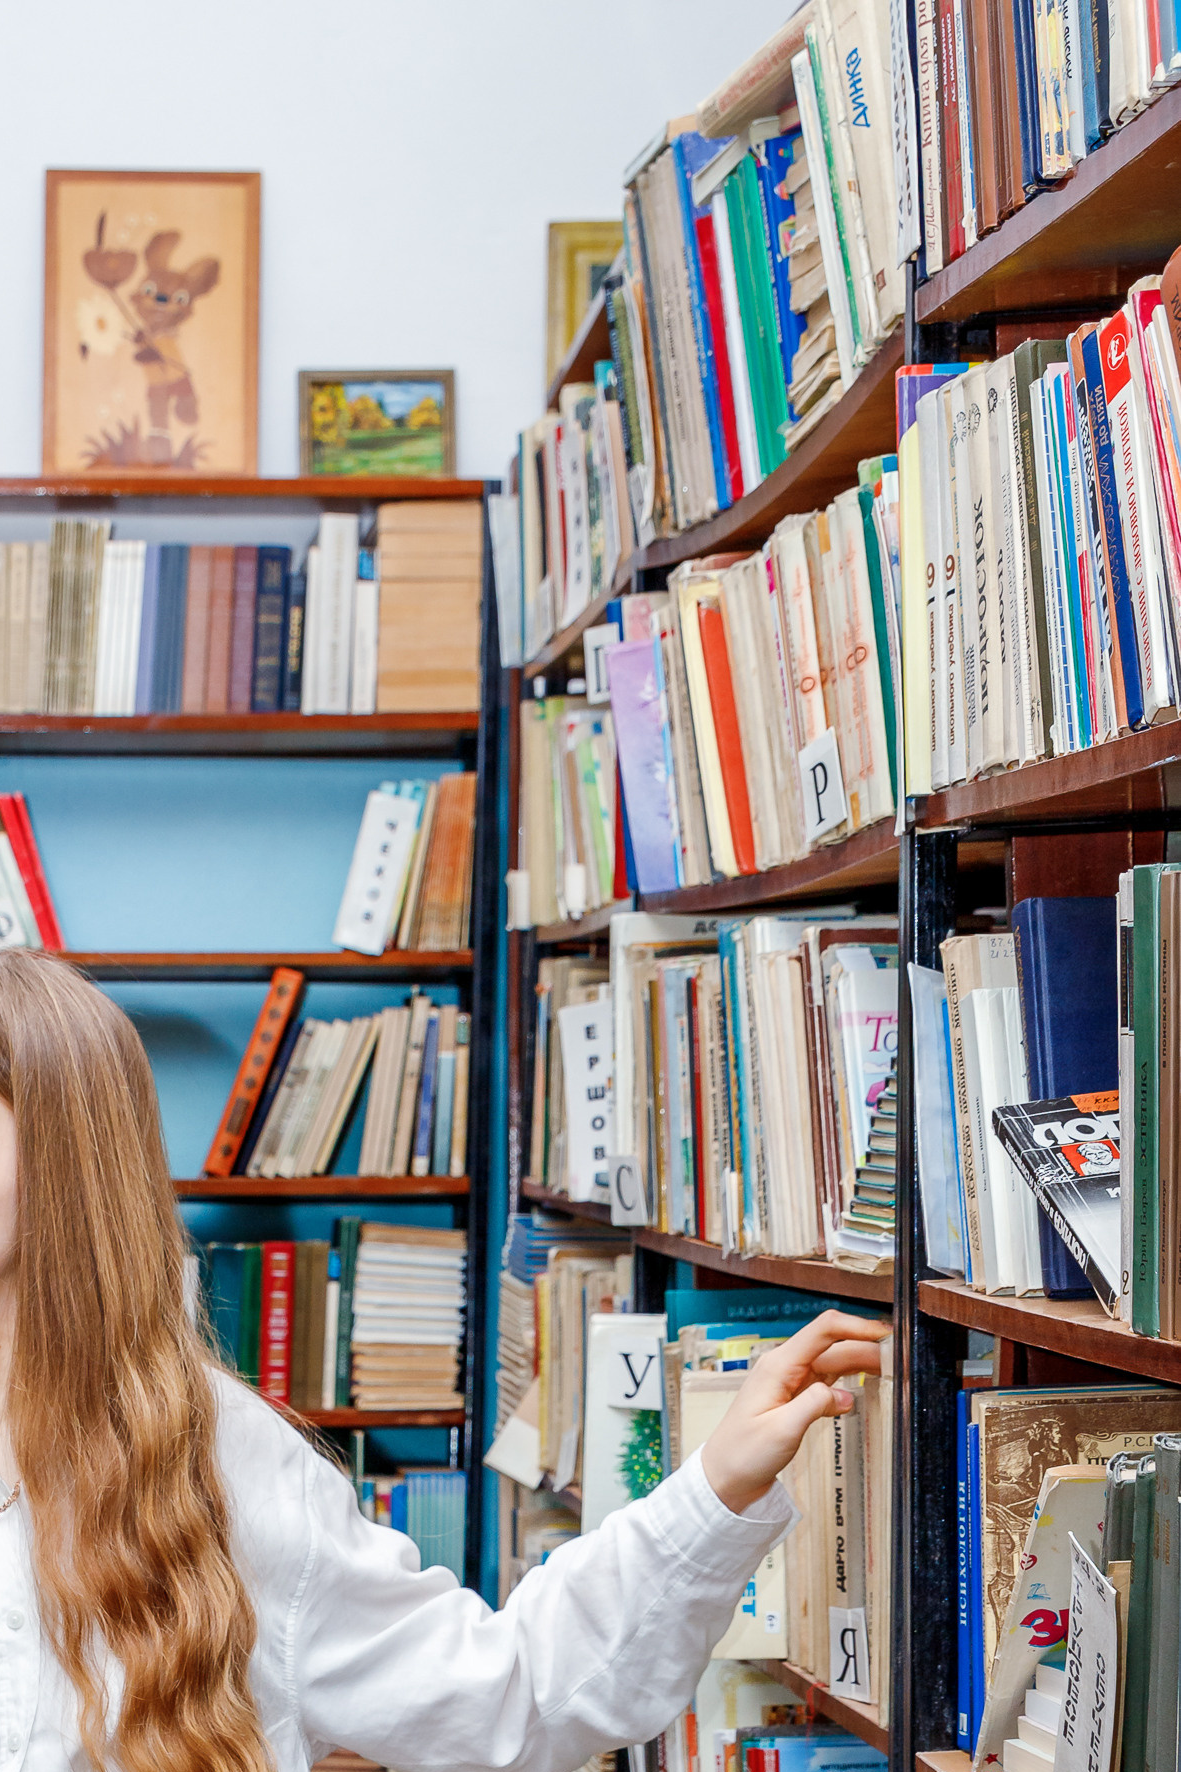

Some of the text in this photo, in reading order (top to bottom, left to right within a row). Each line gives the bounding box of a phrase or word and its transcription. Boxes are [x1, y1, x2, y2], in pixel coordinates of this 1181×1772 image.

[916, 0, 932, 28] ро
[947, 13, 956, 81] МАКАРЕНКО
[920, 80, 934, 149] Книга
[1092, 383, 1109, 446] ДО ПЯТИ
[1116, 400, 1134, 473] ЛОГИКОЙ
[1127, 490, 1143, 572] ЛЮБОВЬЮ
[946, 603, 957, 668] учебника
[972, 493, 991, 717] ПОДРОСТОК
[927, 611, 937, 675] учебника
[1136, 590, 1154, 691] ВОСПИТАНИЕ
[928, 678, 937, 752] школьного
[947, 671, 956, 746] школьного
[808, 760, 829, 826] Р
[584, 1024, 608, 1162] ЕРШОВ
[956, 1036, 969, 1116] ПРАВИЛЬНО
[1032, 1116, 1119, 1147] ЛОГ
[614, 1163, 634, 1212] С
[1137, 1060, 1150, 1282] Юрий Борев ЭСТЕТИКА
[619, 1351, 656, 1400] У
[834, 1535, 847, 1593] Дарю
[957, 1479, 967, 1627] ПСИХОЛОГИЯ
[835, 1626, 861, 1686] Я
